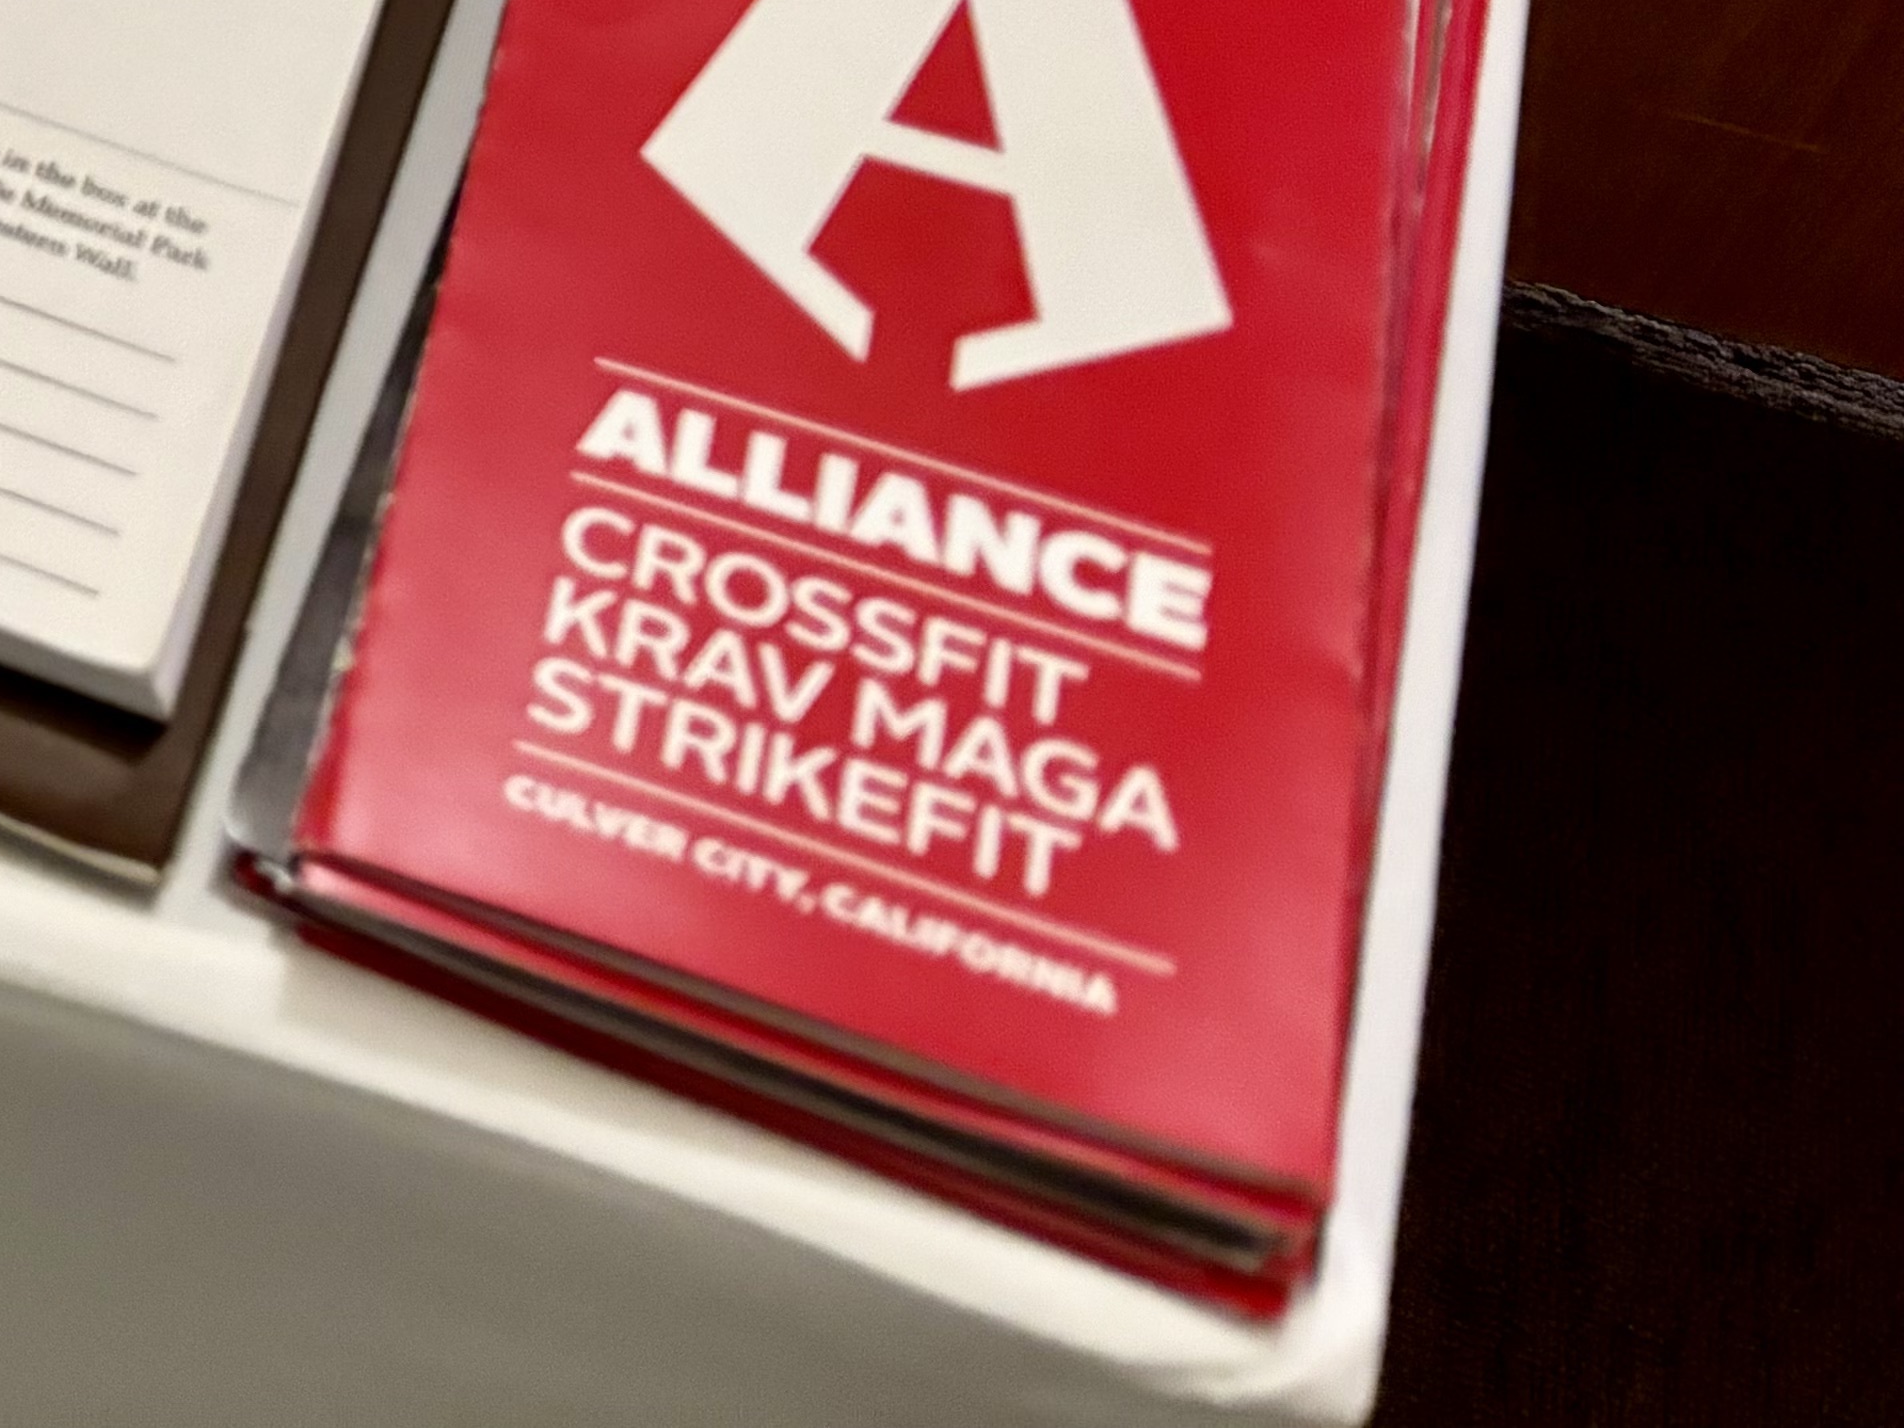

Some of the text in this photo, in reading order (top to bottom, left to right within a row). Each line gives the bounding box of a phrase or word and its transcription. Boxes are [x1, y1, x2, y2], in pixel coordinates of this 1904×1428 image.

[560, 506, 1088, 727] CROSSFIT
[577, 389, 1212, 650] ALLIANCE
[526, 656, 1083, 898] STRIKEFIT
[542, 576, 1180, 853] KRAV MAGA
[503, 774, 690, 863] CULVER
[820, 883, 1119, 1016] CALIFORNIA
